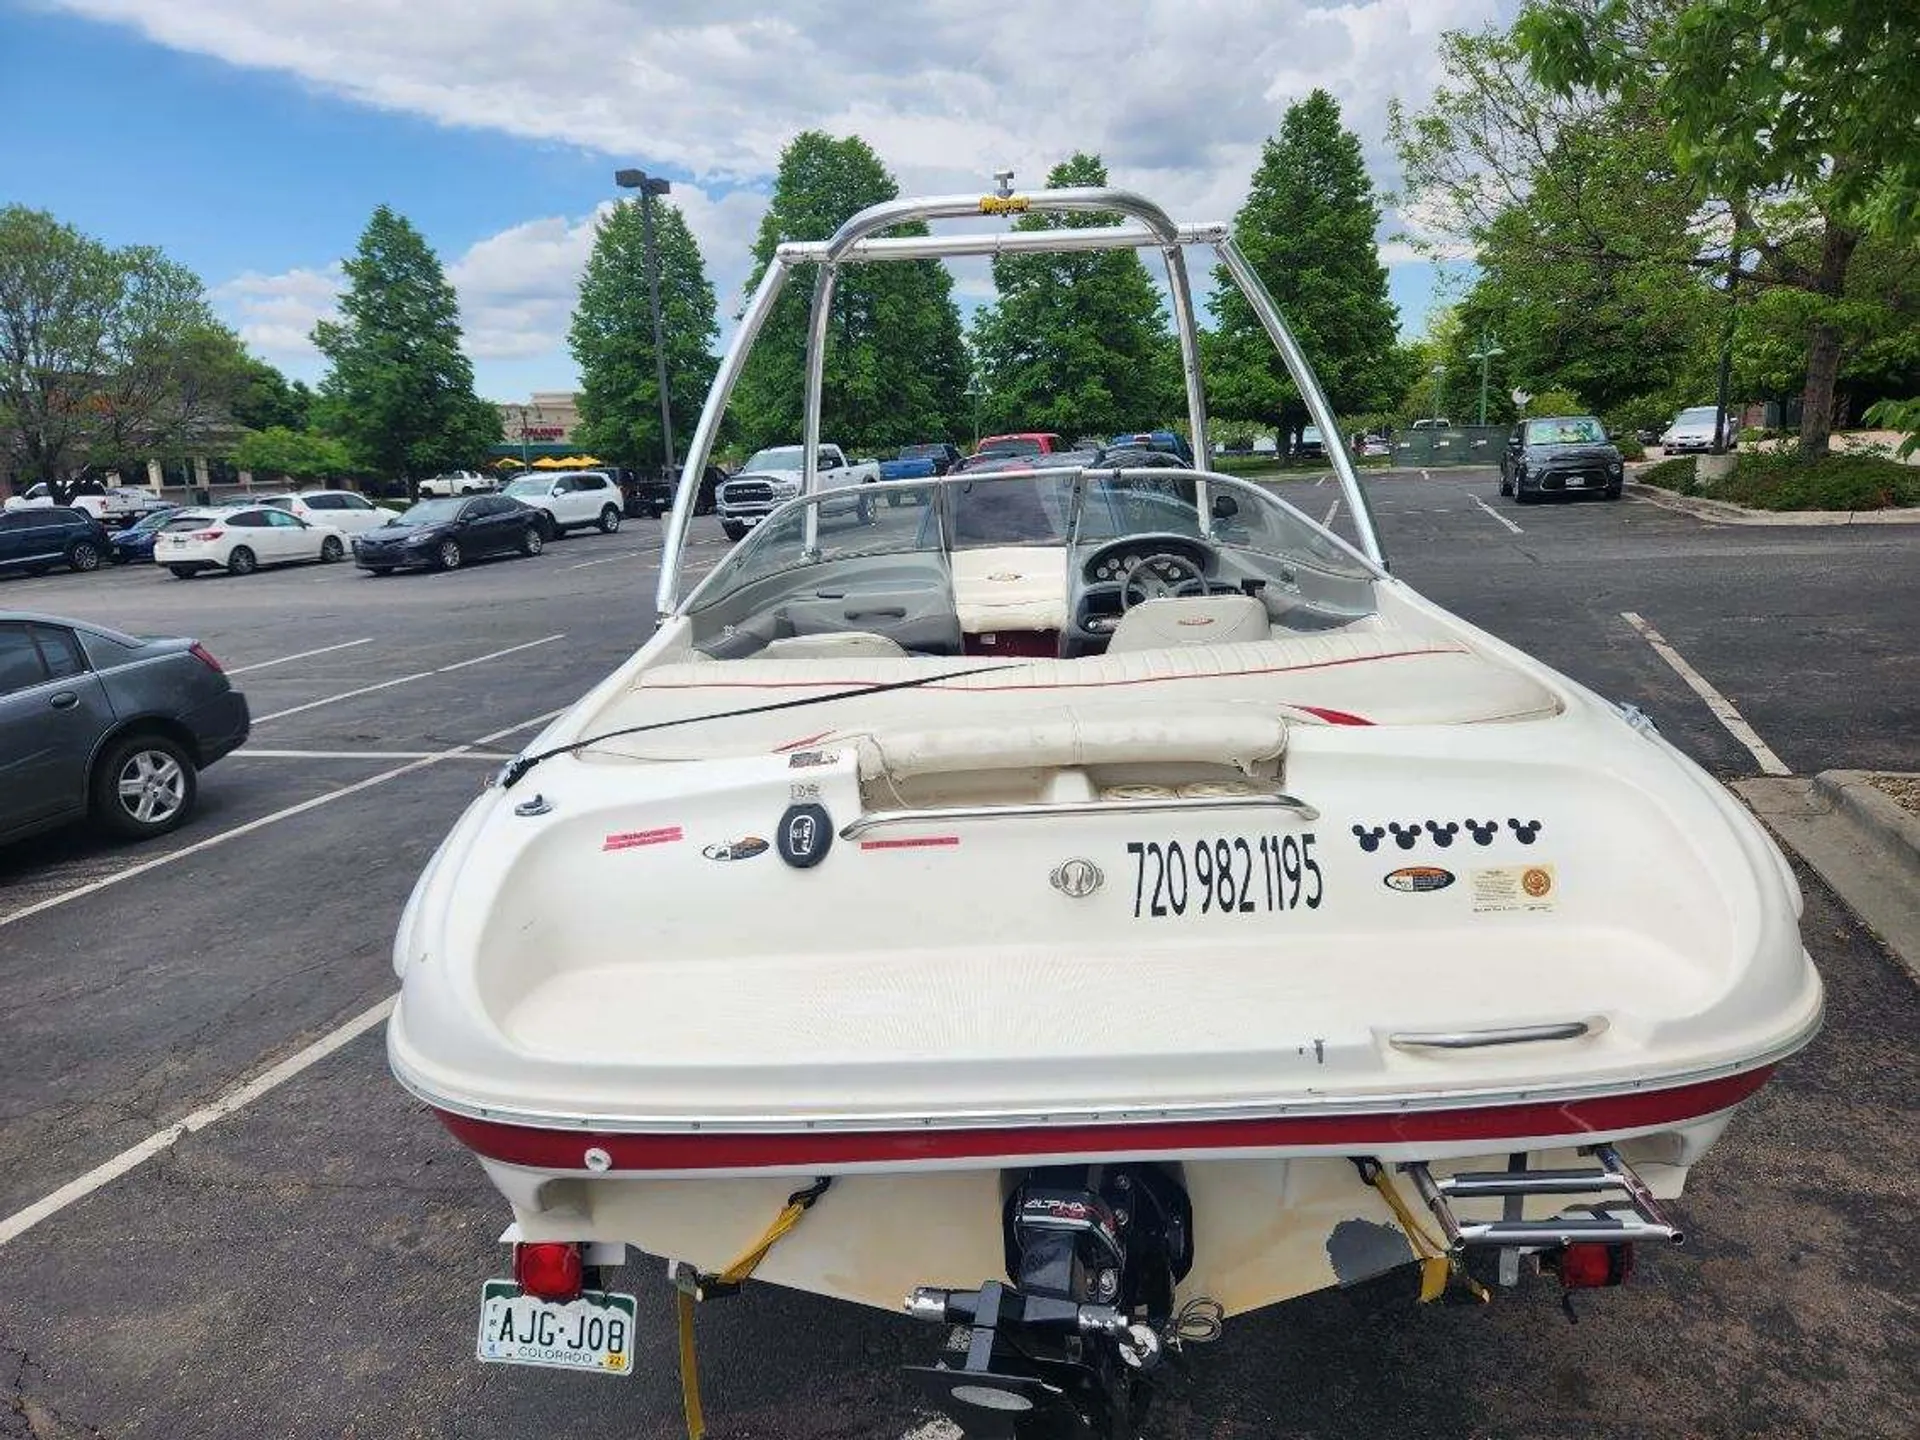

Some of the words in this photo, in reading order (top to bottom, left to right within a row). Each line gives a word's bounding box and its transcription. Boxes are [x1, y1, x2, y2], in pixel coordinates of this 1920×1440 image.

[1127, 841, 1187, 917] 720
[1195, 837, 1255, 914] 982
[1260, 834, 1322, 910] 1195
[1023, 1199, 1086, 1212] ALPHA
[517, 1346, 592, 1363] COLORADO
